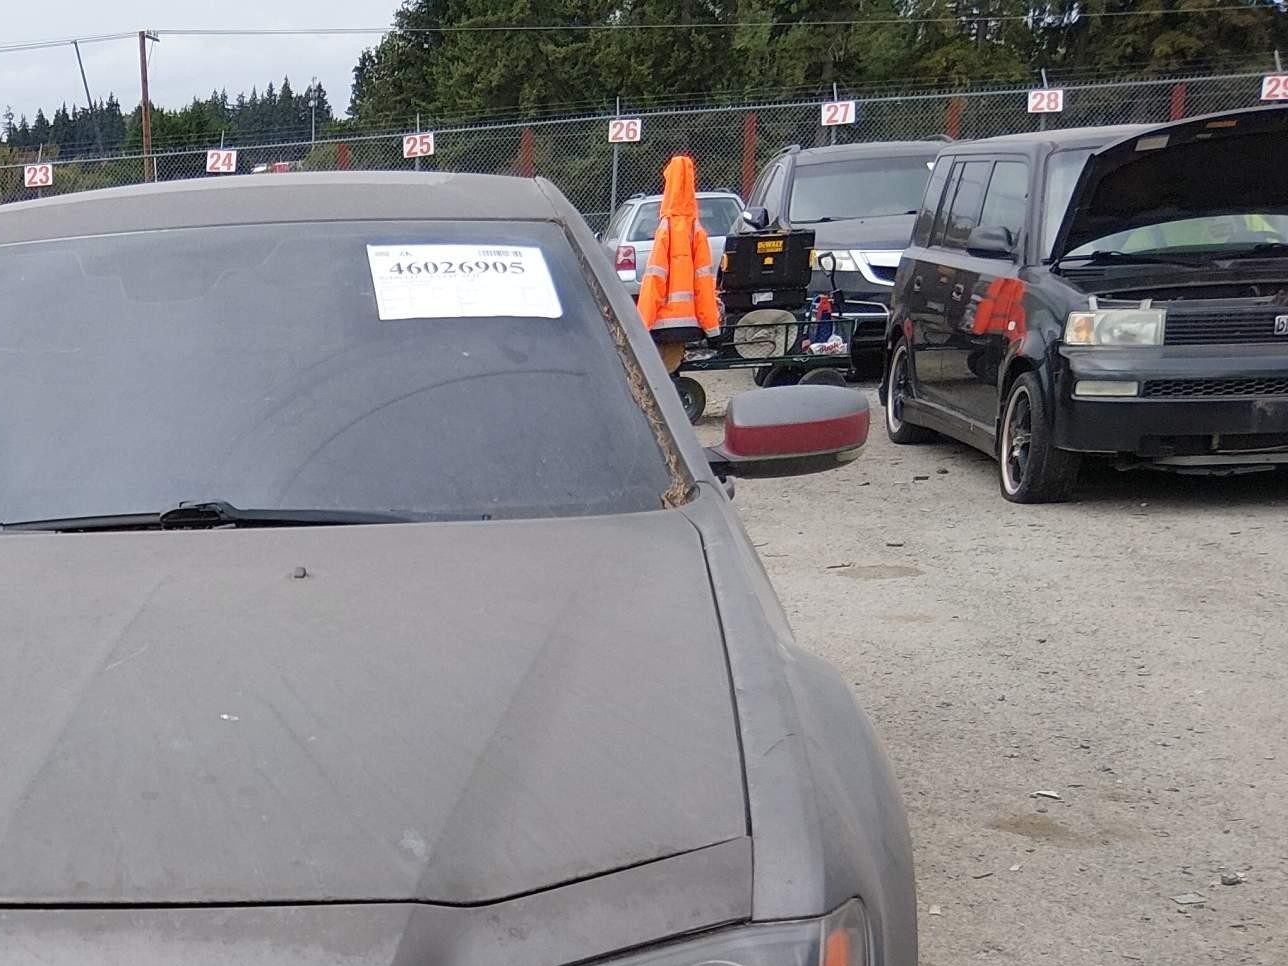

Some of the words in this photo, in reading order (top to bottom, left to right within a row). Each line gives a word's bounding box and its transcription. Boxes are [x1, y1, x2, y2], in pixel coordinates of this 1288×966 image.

[1032, 91, 1059, 111] 28
[826, 104, 850, 124] 27
[611, 121, 638, 140] 26
[405, 135, 431, 156] 25
[209, 152, 233, 170] 24
[26, 166, 50, 185] 23
[389, 261, 525, 276] 46026905
